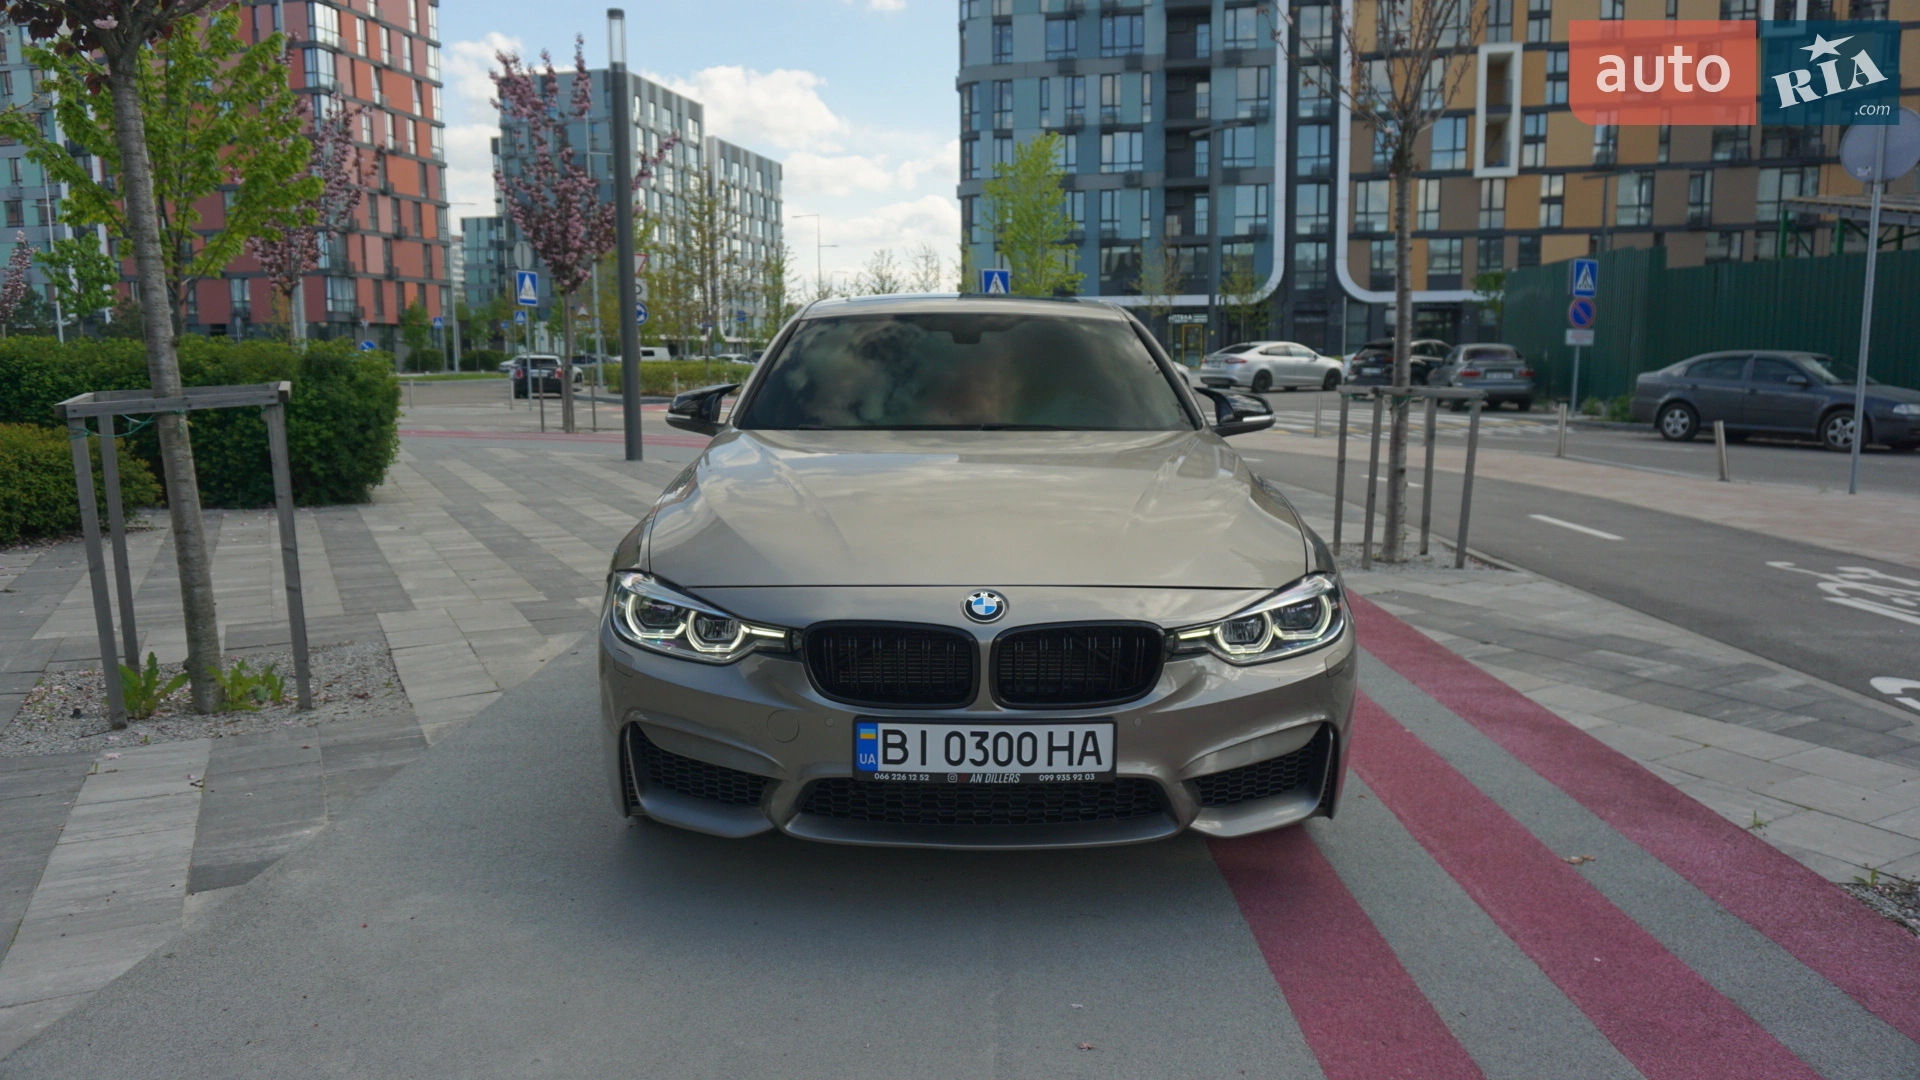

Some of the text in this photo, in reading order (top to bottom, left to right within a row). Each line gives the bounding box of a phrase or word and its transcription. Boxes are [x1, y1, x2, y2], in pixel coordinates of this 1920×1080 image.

[882, 729, 1103, 767] BI 0300 HA
[860, 753, 876, 764] UA
[970, 774, 1021, 783] AN DILLERS
